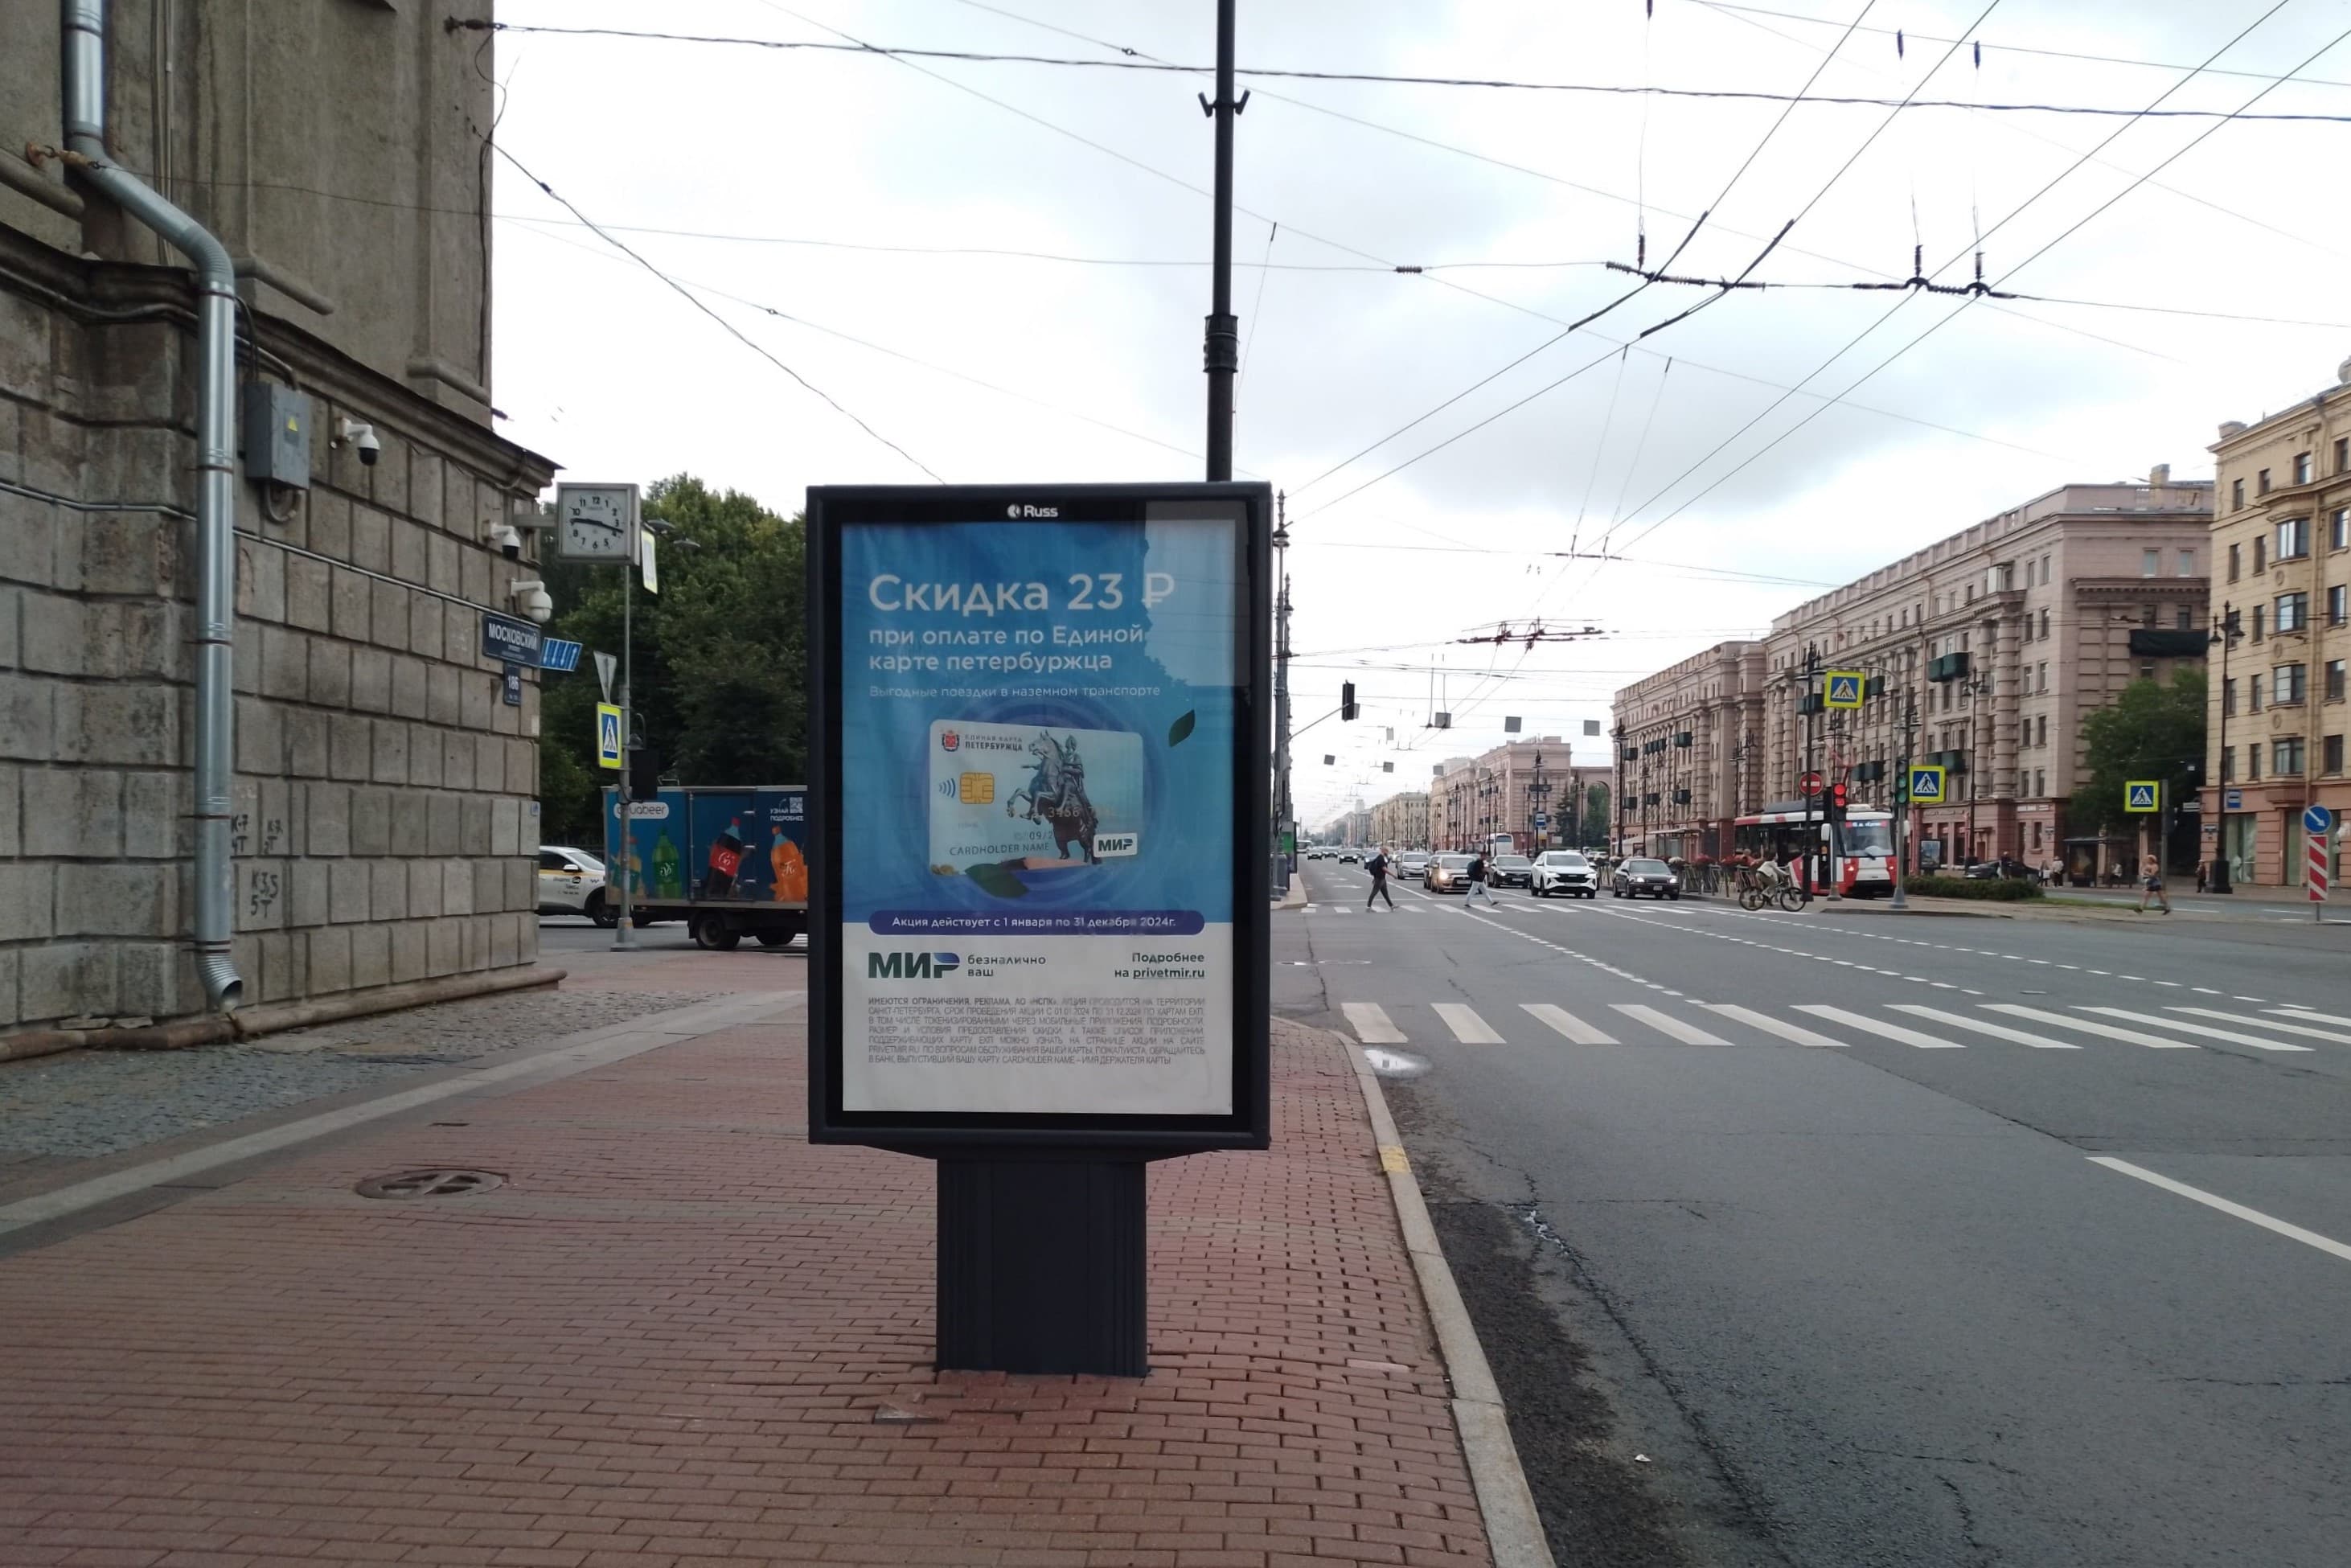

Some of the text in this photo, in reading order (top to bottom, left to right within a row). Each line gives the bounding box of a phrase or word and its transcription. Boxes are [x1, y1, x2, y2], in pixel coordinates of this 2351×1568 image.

[593, 496, 600, 504] 12
[1024, 505, 1058, 517] Russ
[581, 537, 585, 545] 7
[593, 541, 597, 549] 6
[869, 574, 1049, 618] Скидка
[1068, 573, 1123, 610] 23
[488, 622, 537, 651] МОСКОВСКИЙ
[869, 623, 1143, 647] при оплате по Единой
[869, 651, 1113, 673] карте петербуржца
[870, 686, 1160, 699] Выгодные поездки в наземном транспорте
[965, 741, 1023, 752] ПЕТЕРБУРЖЦА
[950, 843, 1049, 856] CARDHOLDER NAME
[1098, 839, 1133, 852] МИР
[892, 917, 928, 927] Акция
[932, 917, 990, 927] действует
[1003, 917, 1007, 926] 1
[1011, 919, 1052, 927] января
[1074, 917, 1085, 926] 31
[1088, 917, 1137, 927] декабря
[1140, 917, 1176, 927] 2024г.
[968, 954, 1046, 965] безналично
[1132, 952, 1205, 964] Подробнее
[868, 952, 960, 979] МИР
[968, 968, 994, 977] ваш
[1114, 968, 1205, 979] на privetmir.ru
[868, 997, 909, 1005] ИМЕЮТСЯ
[1016, 997, 1026, 1005] АО
